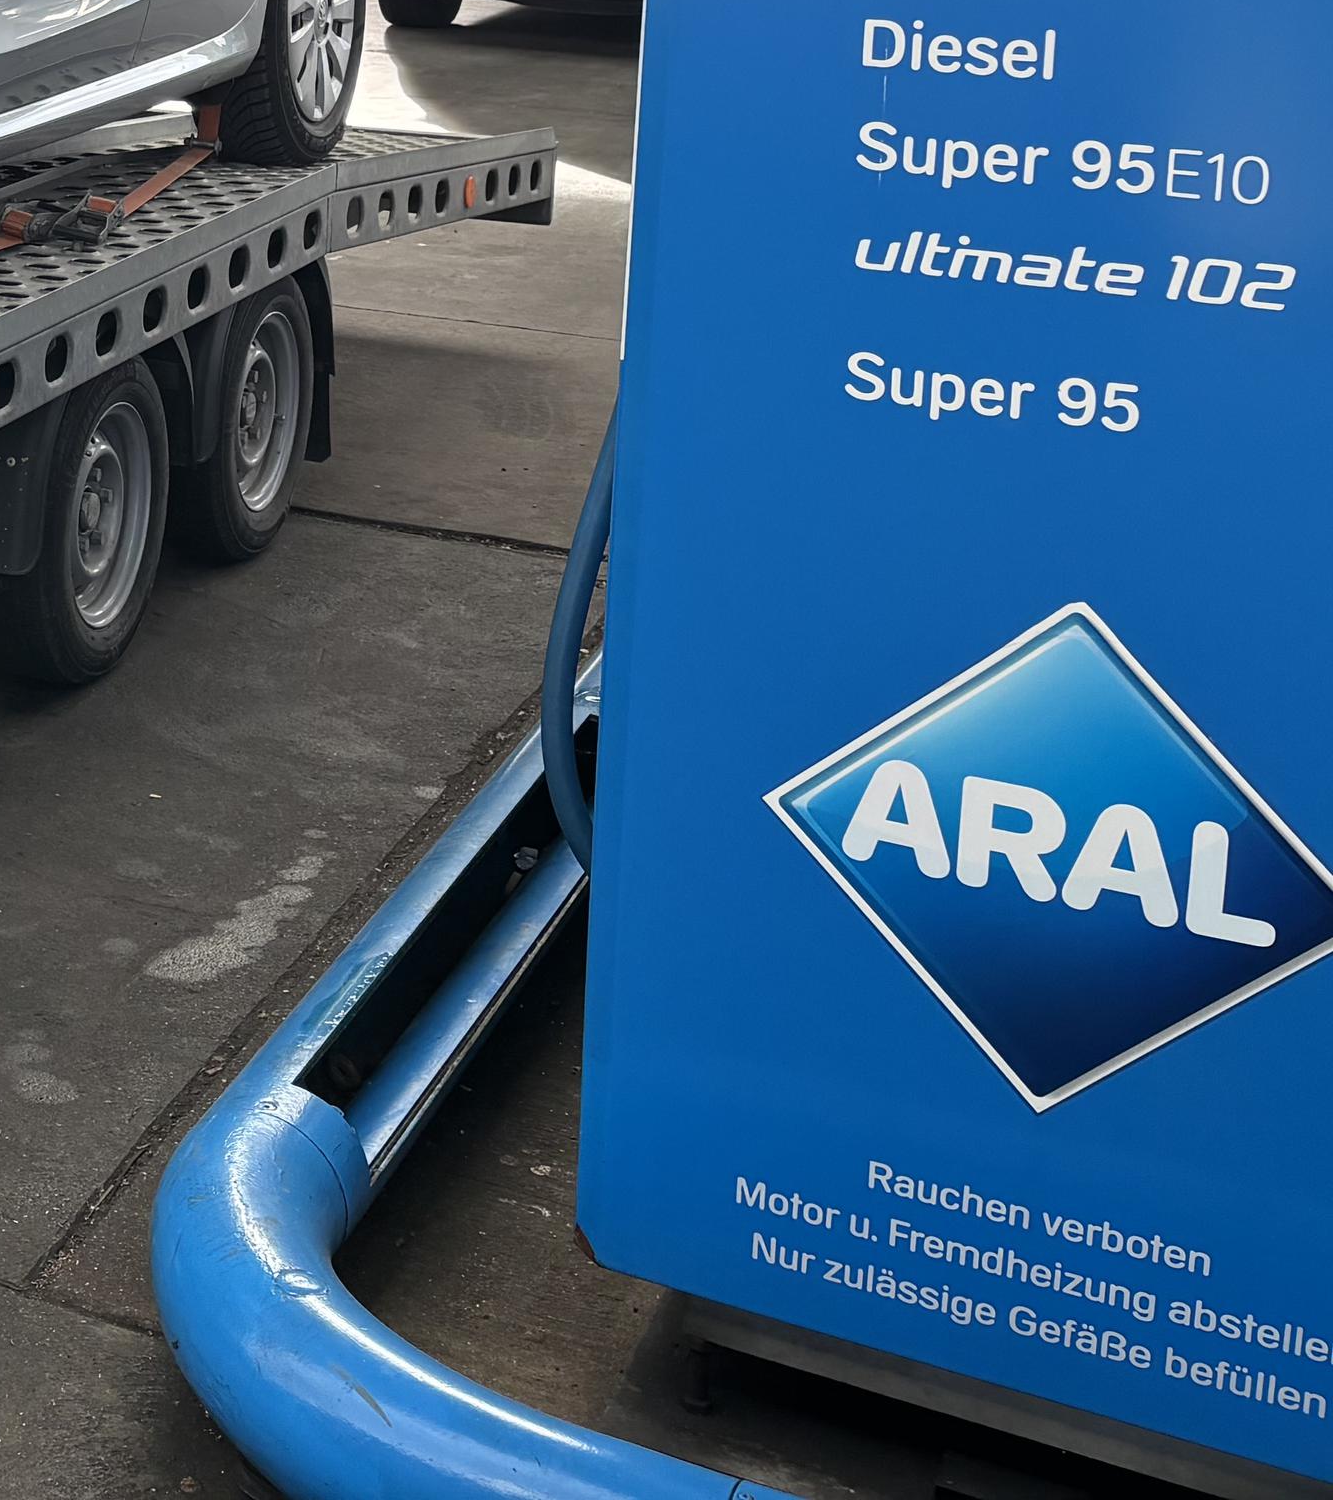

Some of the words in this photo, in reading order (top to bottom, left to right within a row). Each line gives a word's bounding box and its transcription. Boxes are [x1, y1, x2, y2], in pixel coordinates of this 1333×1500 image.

[861, 19, 1056, 80] Diesel
[855, 120, 1050, 188] Super
[854, 231, 1145, 297] ultimate
[1165, 256, 1297, 312] 102
[844, 351, 1035, 421] Super
[1056, 377, 1141, 434] 95
[841, 759, 1277, 949] ARAL
[866, 1161, 1030, 1231] Rauchen
[1041, 1208, 1212, 1277] verboten
[735, 1177, 840, 1234] Motor
[850, 1216, 879, 1243] u.
[888, 1219, 1156, 1321] Fremdheizung
[1168, 1299, 1333, 1366] abstelle
[752, 1233, 813, 1278] Nur
[823, 1257, 998, 1328] zulässige
[1009, 1307, 1153, 1371] Gefäße
[1164, 1346, 1327, 1419] befüllen
